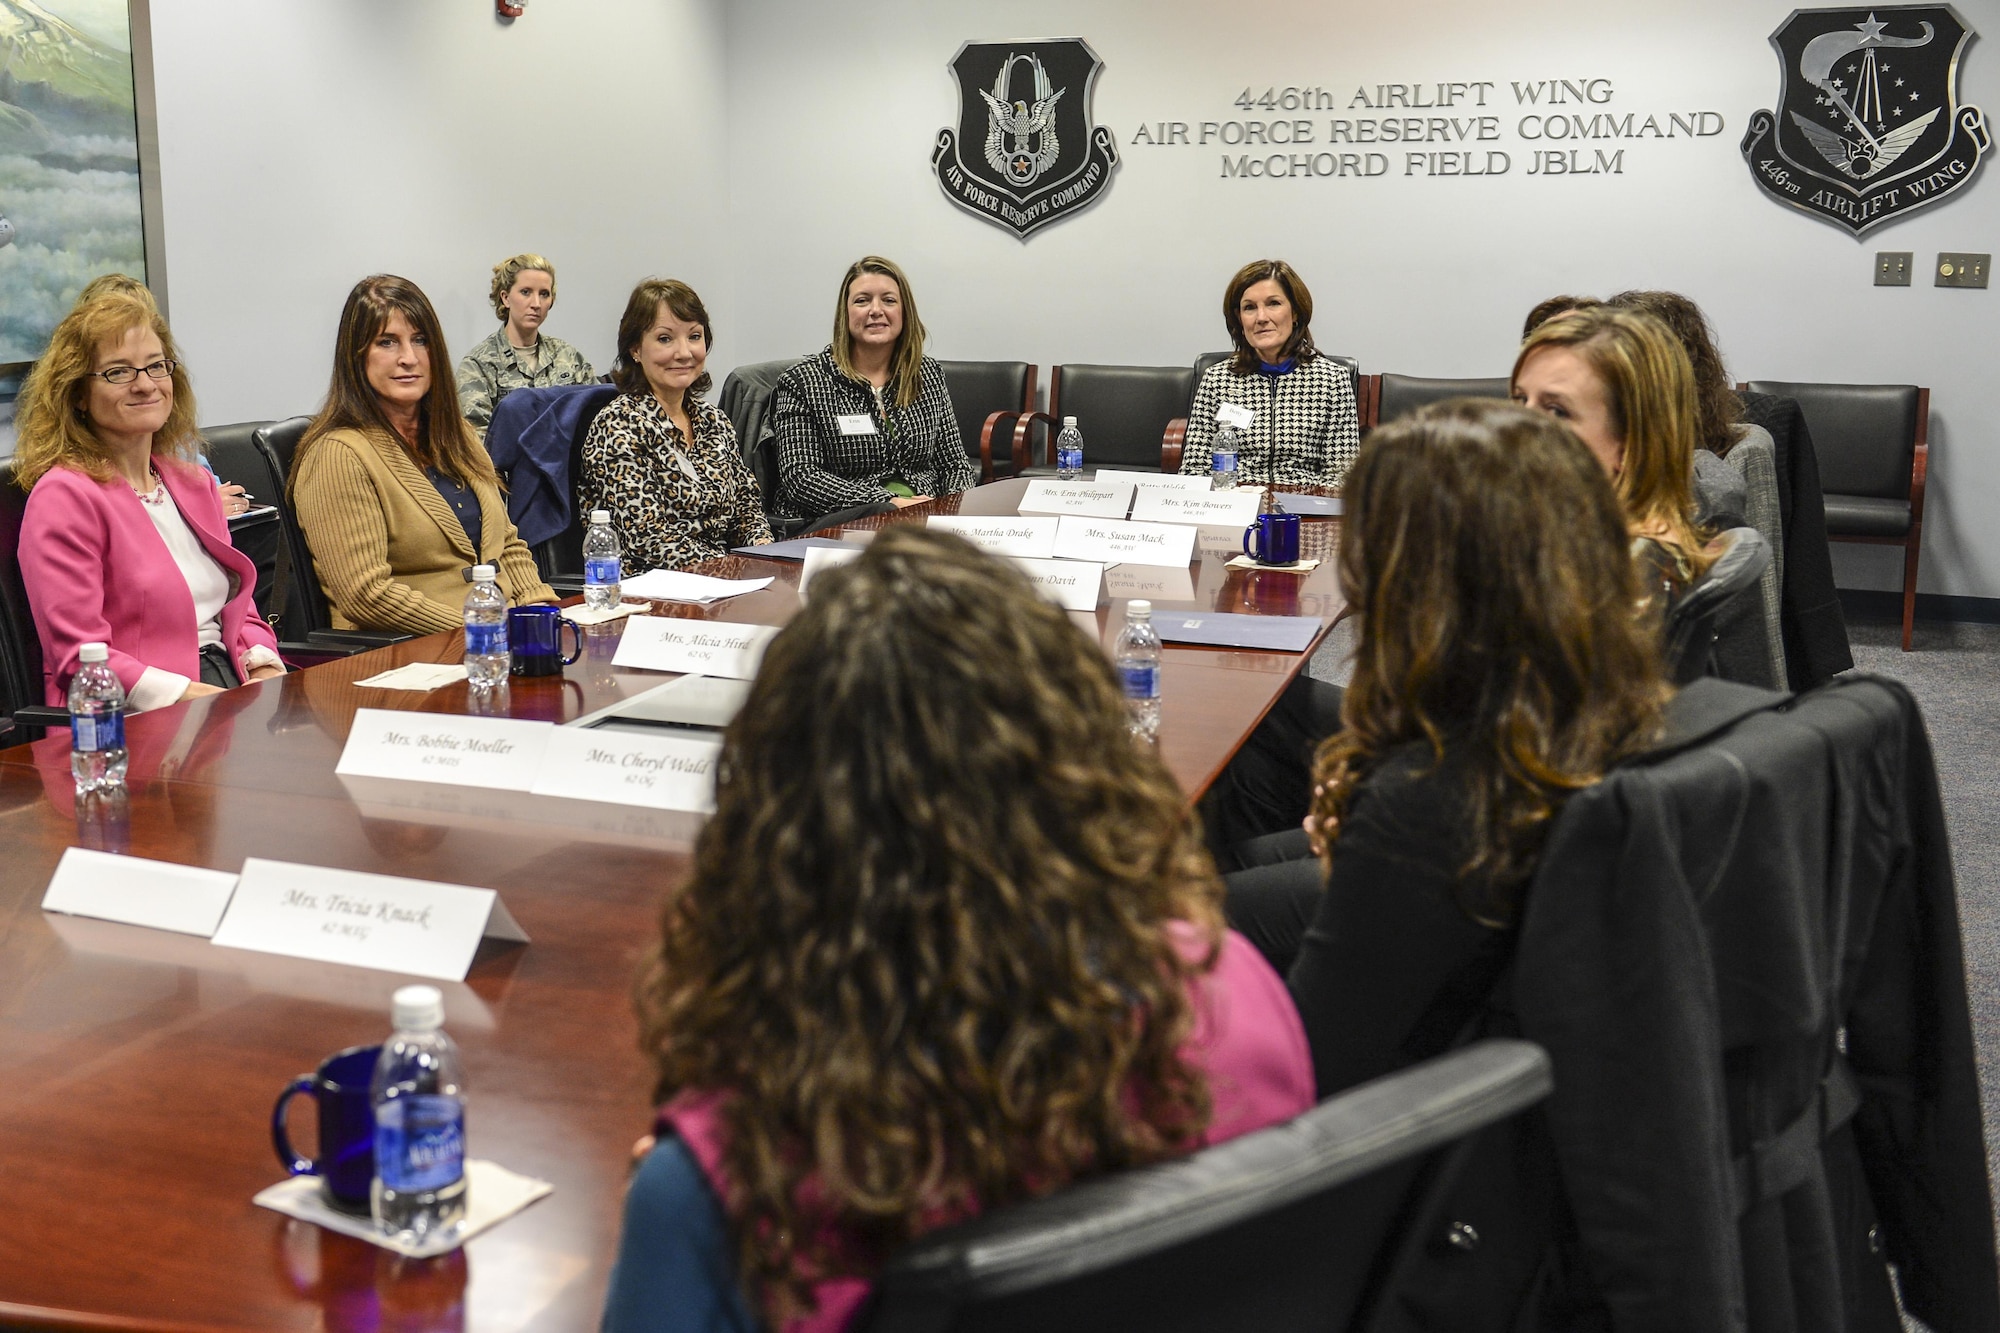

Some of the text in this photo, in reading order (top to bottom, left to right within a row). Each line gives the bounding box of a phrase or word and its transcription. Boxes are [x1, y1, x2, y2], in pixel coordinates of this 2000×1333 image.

[1234, 79, 1613, 110] 446th AIRLIFT WING
[1131, 111, 1725, 145] AIR FORCE RESERVE COMMAND
[1221, 149, 1624, 177] McCHORD FIELD JBLM
[946, 162, 1101, 226] AIR FORCE RESERVE COMMAND
[1808, 189, 1901, 223] AIRLIFT
[1906, 158, 1967, 198] WING
[1042, 488, 1058, 497] Mrs.
[1060, 489, 1077, 498] Erin
[1162, 498, 1233, 510] Mrs. Kim Bowers
[970, 528, 1004, 537] Martha
[1006, 528, 1034, 539] Drake
[1085, 528, 1166, 545] Mrs. Susan Mack
[659, 631, 684, 644] Mrs.
[686, 634, 721, 648] Alicia
[688, 650, 698, 658] 62
[382, 731, 515, 755] Mrs. Bobbie Moeller
[585, 748, 617, 764] Mrs.
[621, 752, 670, 773] Cheryl
